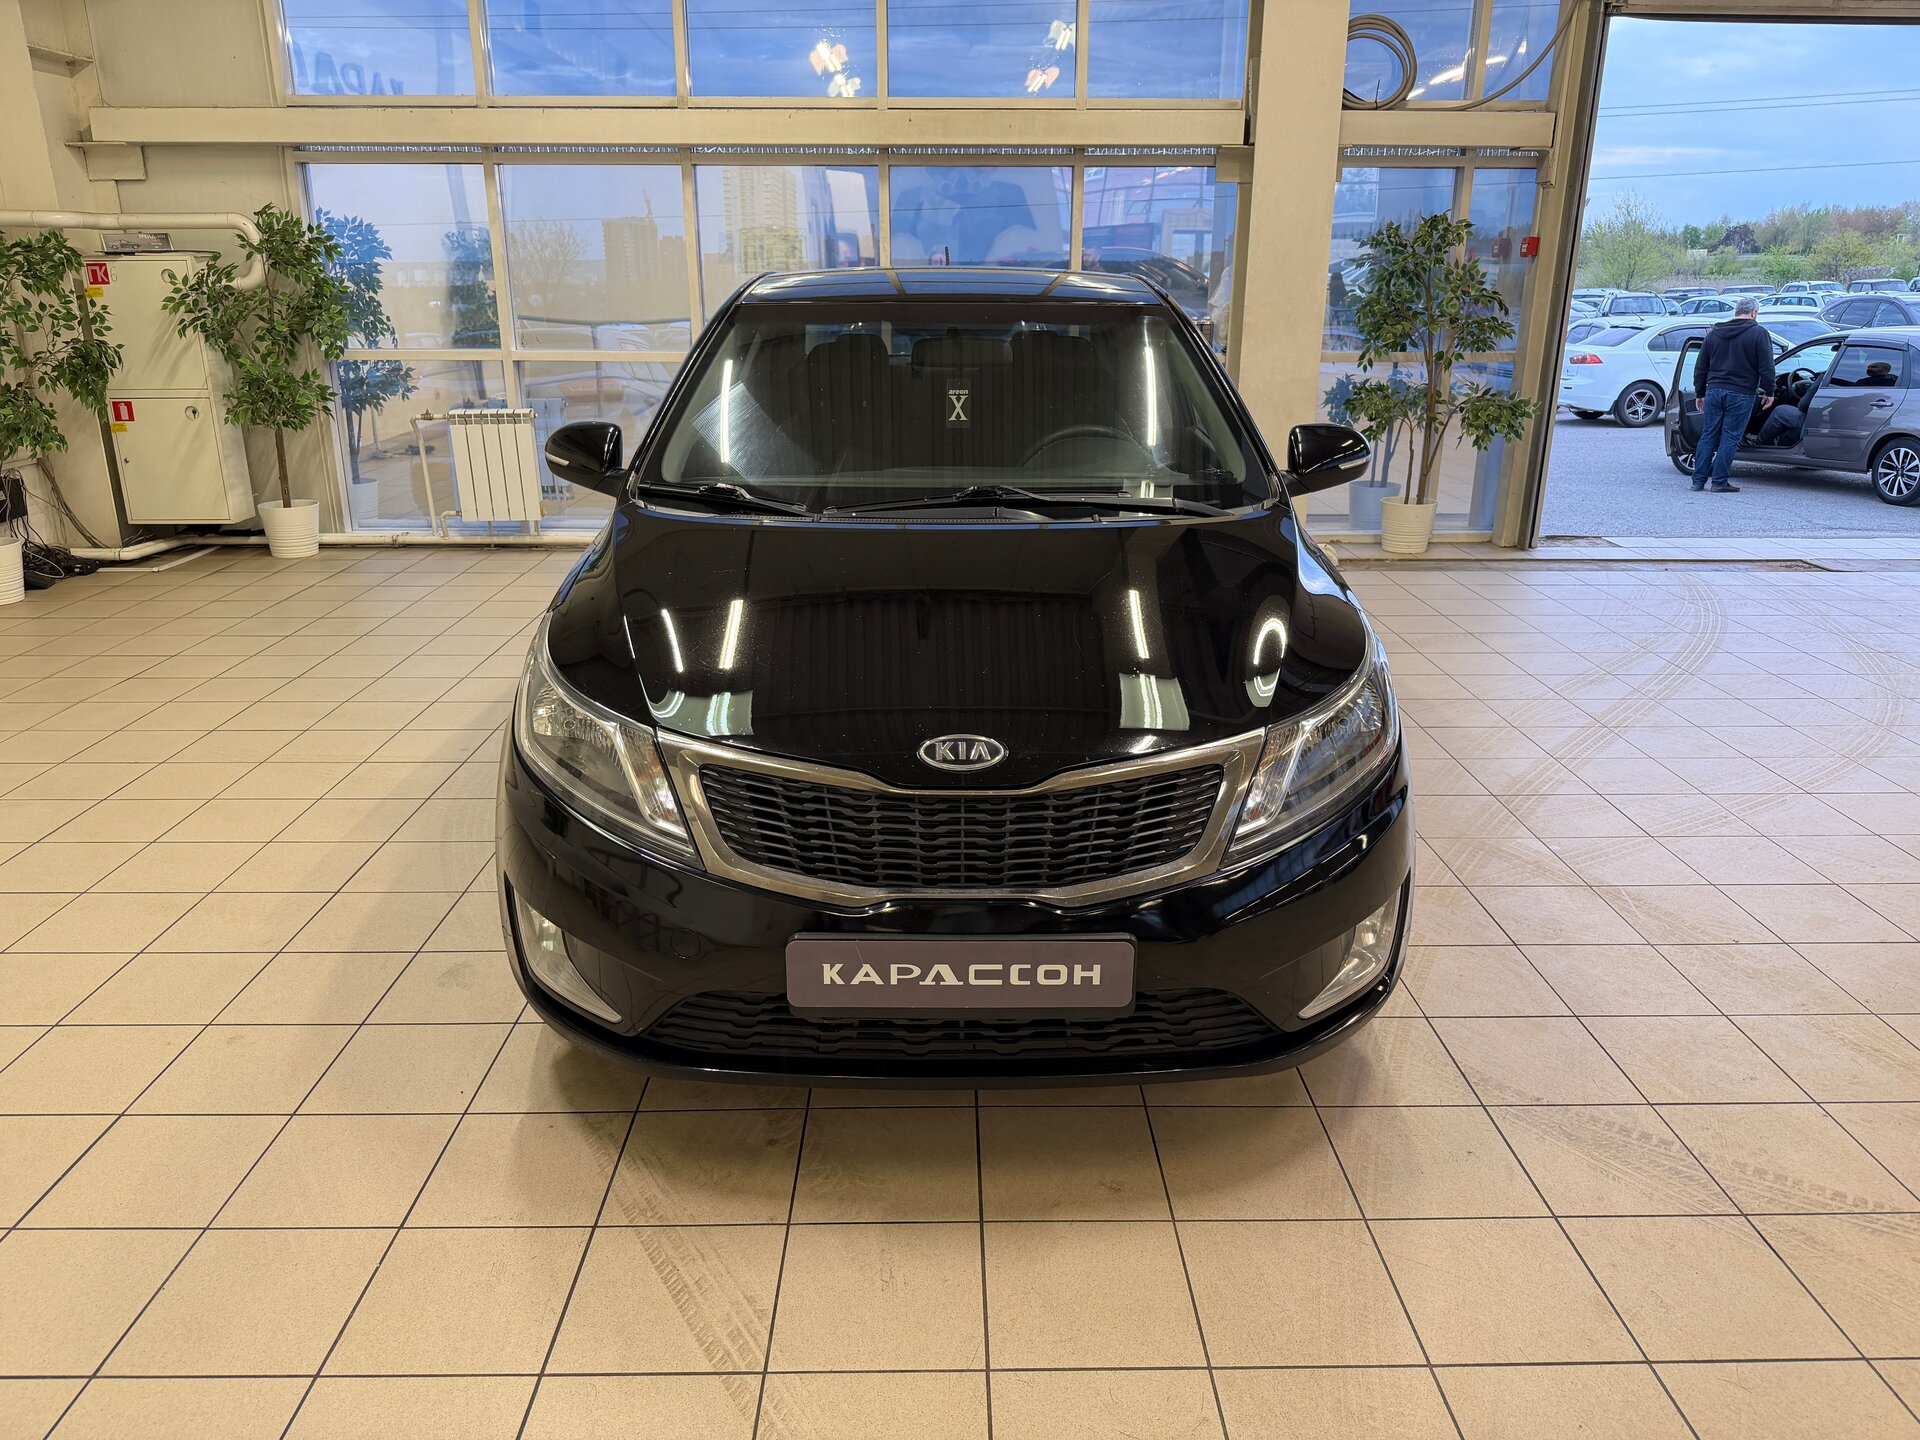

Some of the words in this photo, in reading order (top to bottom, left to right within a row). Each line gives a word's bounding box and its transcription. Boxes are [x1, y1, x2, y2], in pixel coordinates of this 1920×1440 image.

[87, 265, 109, 282] ПК
[948, 395, 969, 421] X
[934, 741, 992, 761] KIA
